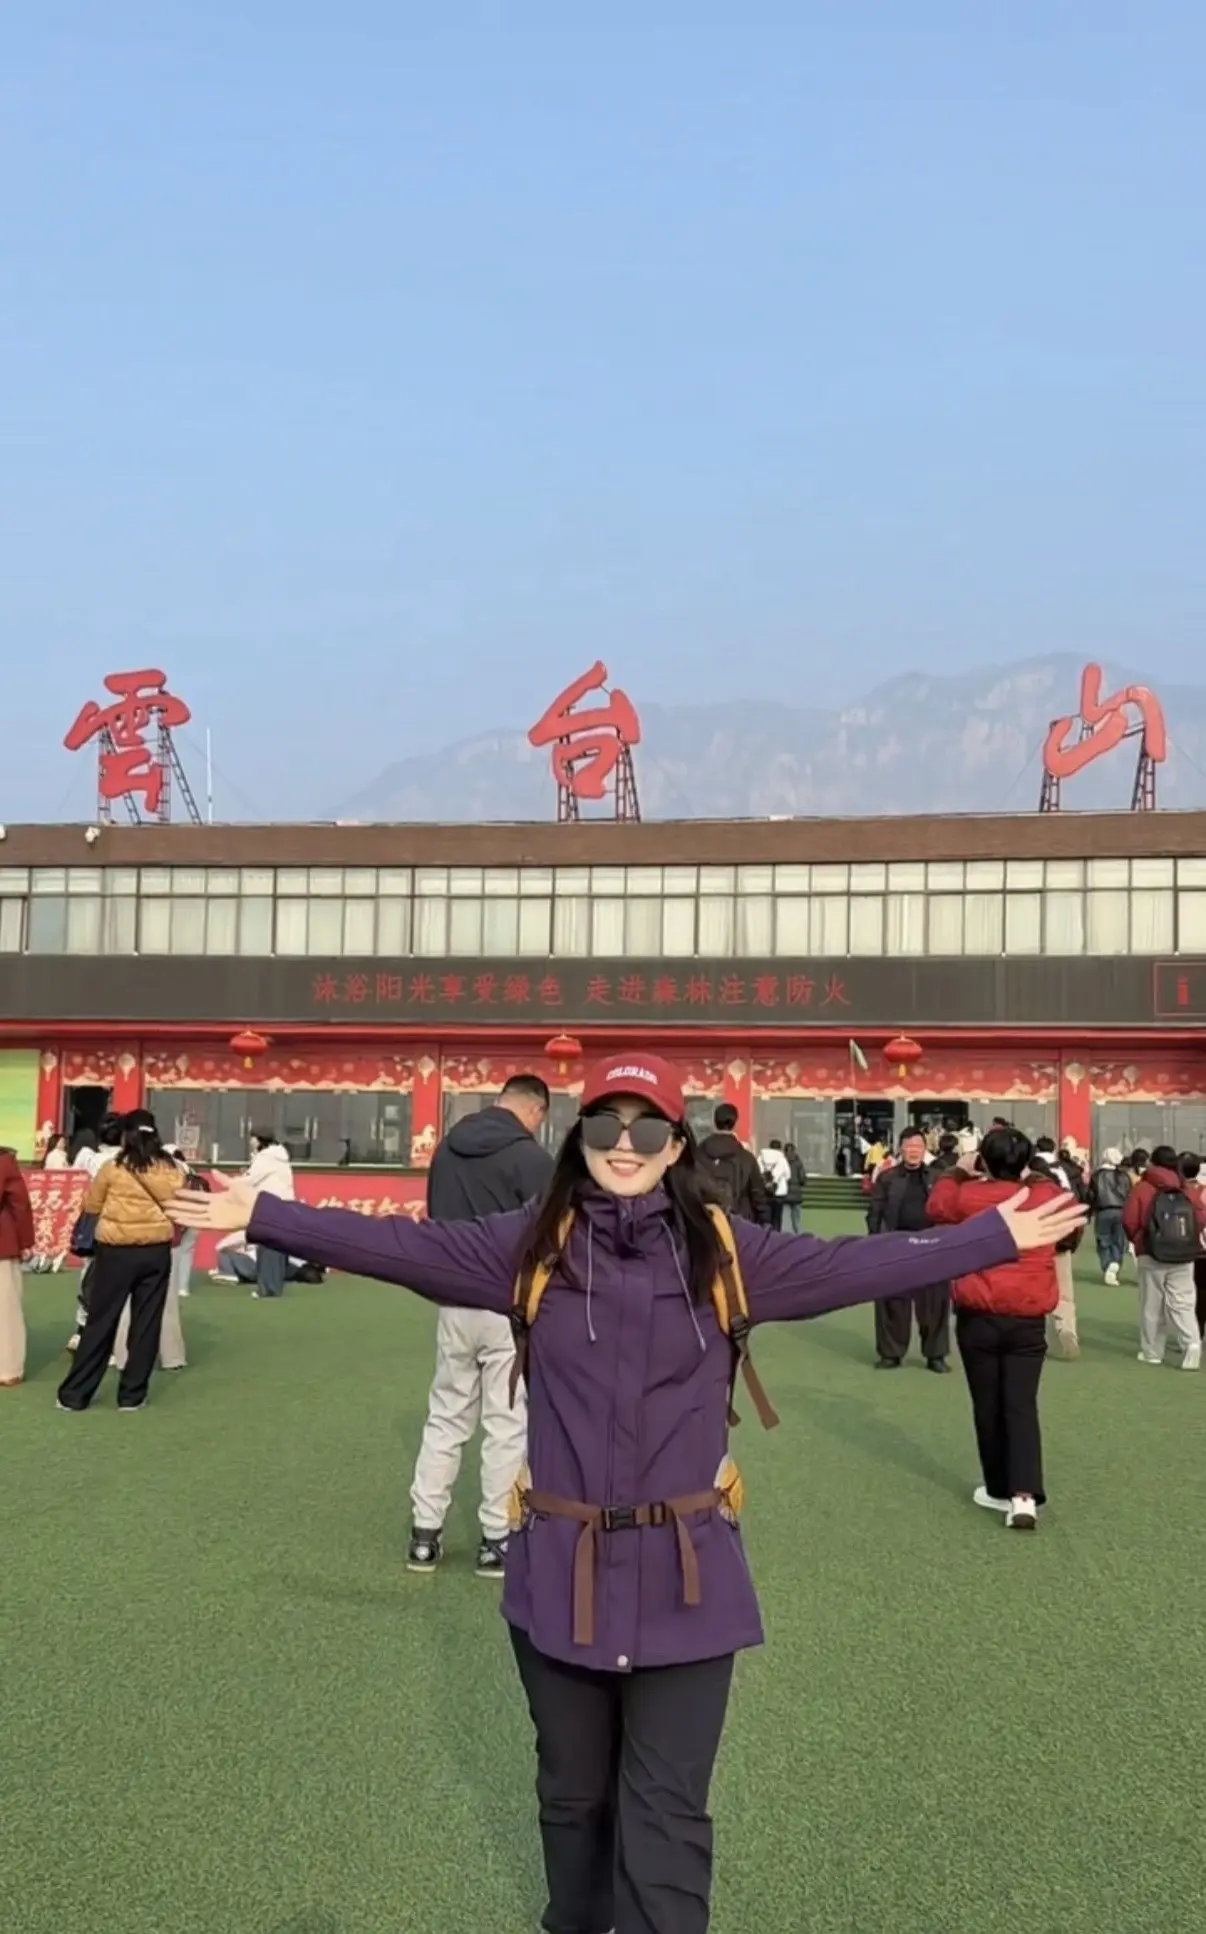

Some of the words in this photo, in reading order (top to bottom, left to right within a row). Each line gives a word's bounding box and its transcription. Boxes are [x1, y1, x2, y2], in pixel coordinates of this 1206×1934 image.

[312, 973, 564, 1006] 沐浴阳光享受绿色
[584, 973, 852, 1007] 走进森林注意防火
